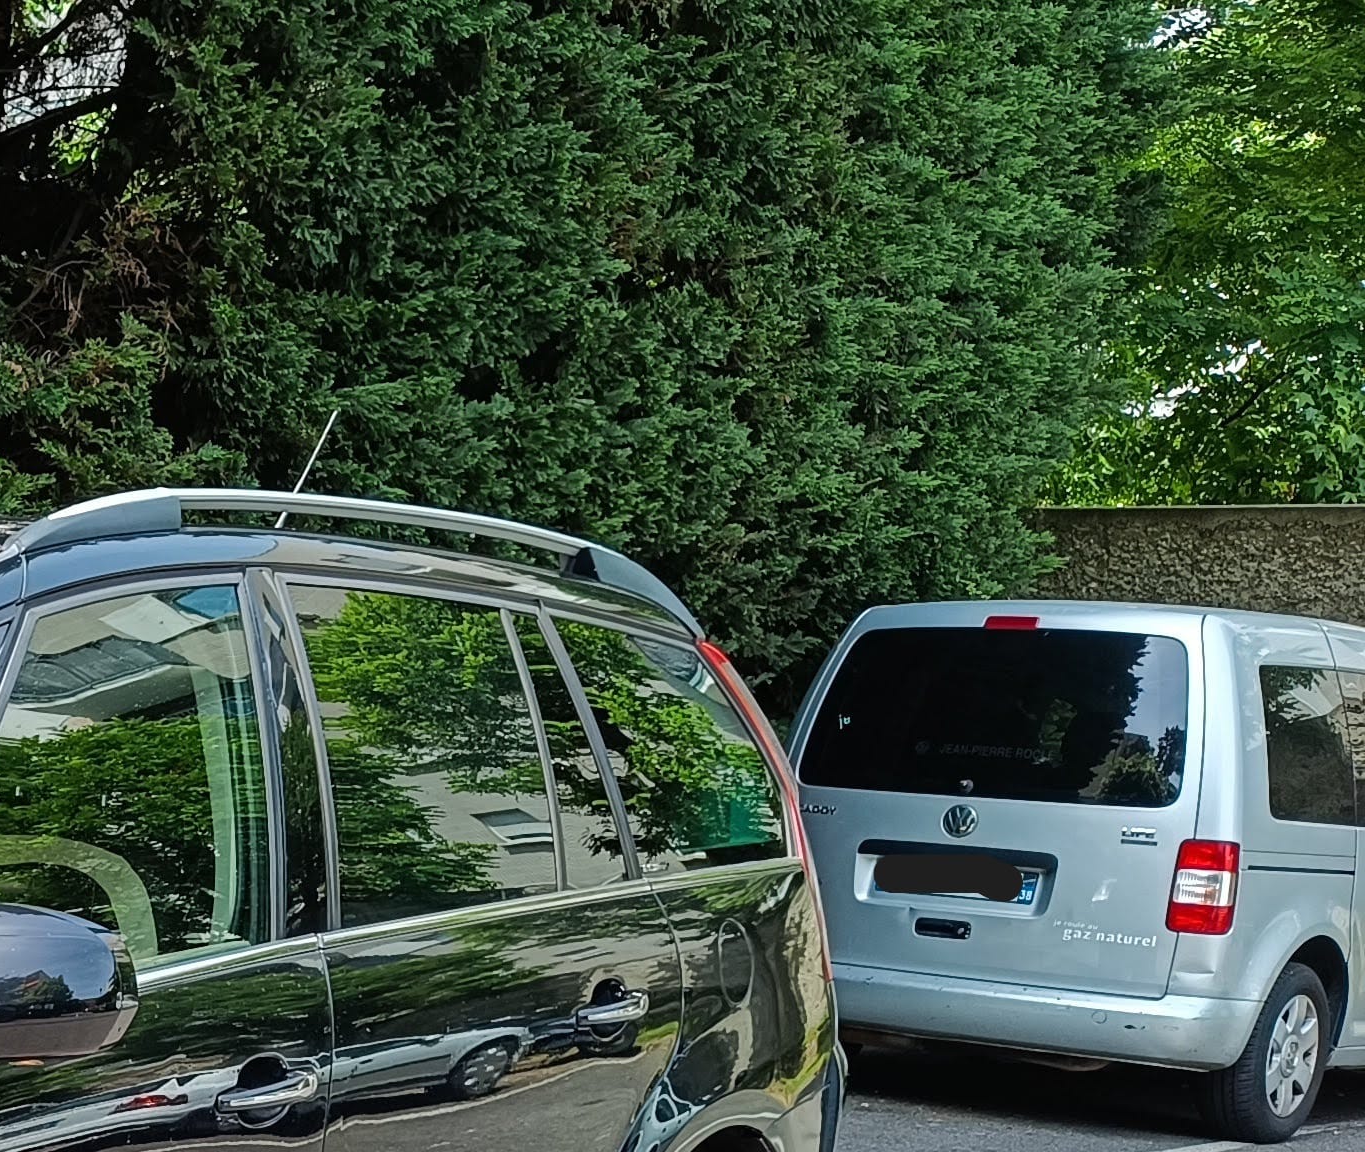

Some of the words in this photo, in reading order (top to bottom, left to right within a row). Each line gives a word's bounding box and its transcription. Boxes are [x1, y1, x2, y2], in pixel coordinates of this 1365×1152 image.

[1019, 889, 1032, 901] 38
[1062, 928, 1091, 941] gaz
[1096, 932, 1157, 948] naturel
